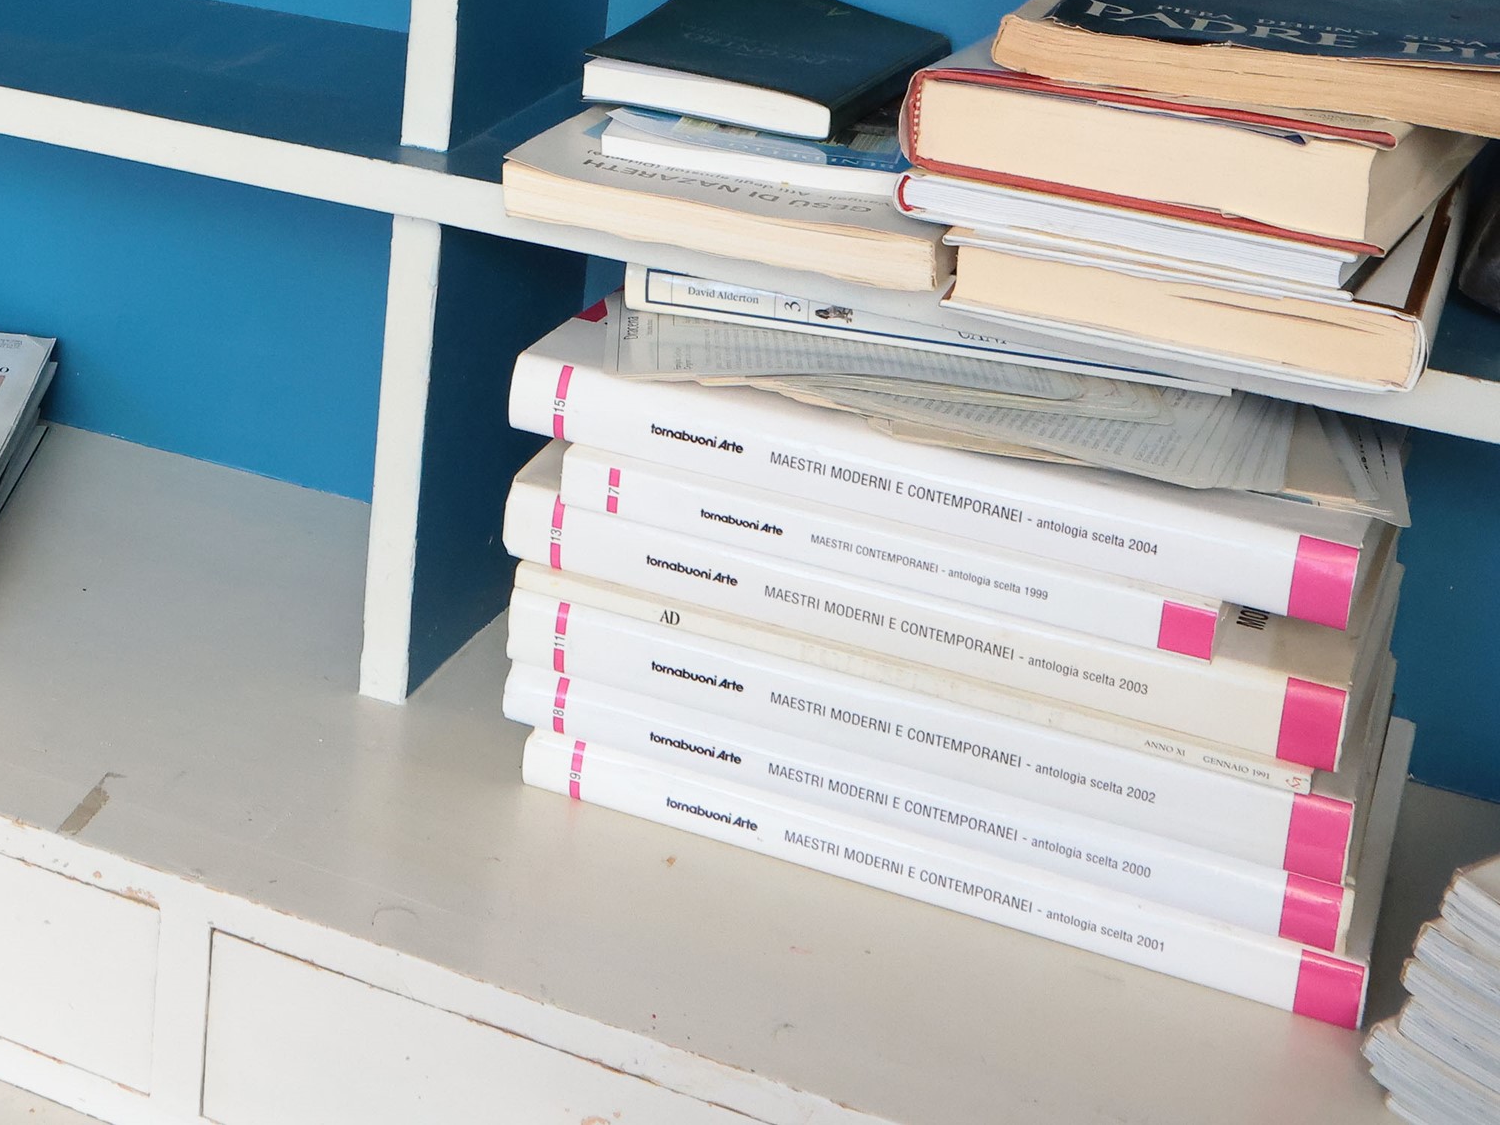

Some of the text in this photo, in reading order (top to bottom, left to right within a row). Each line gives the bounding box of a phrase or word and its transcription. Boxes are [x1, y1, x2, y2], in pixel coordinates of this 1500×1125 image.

[1086, 0, 1357, 49] PADRE
[583, 159, 739, 194] NAZARETH
[750, 191, 780, 203] DI
[688, 286, 760, 305] David Alderton
[553, 400, 566, 414] 15
[608, 487, 620, 496] 7
[651, 423, 1158, 555] tornabuoni Arte MAESTRI MODERNI E CONTEMPORANEI antologia scelta 2004
[551, 528, 562, 542] 13
[700, 508, 1049, 600] tornabuoni Arte MAESTRI CONTEMPORANEI antologia scelta 1999
[554, 635, 565, 647] 11
[646, 554, 1148, 695] tornabuoni Arte MAESTRI MODERNI E CONTEMPORANEI antologia scelta 2003
[659, 610, 1270, 779] AD ANNO XI GENNAIO 1991
[553, 708, 564, 717] 8
[651, 661, 1156, 804] tornabuoni Arte MAESTRI MODERNI E CONTEMPORANEI antologia scelta 2002
[570, 772, 581, 780] 9
[650, 731, 1151, 878] tornabuoni Arte MAESTRI MODERNI E CONTEMPORANEI antologia scelta 2000
[666, 796, 1165, 952] tornabuoni Arte MAESTRI MODERNI E CONTEMPORANEI antologia scelta 2001
